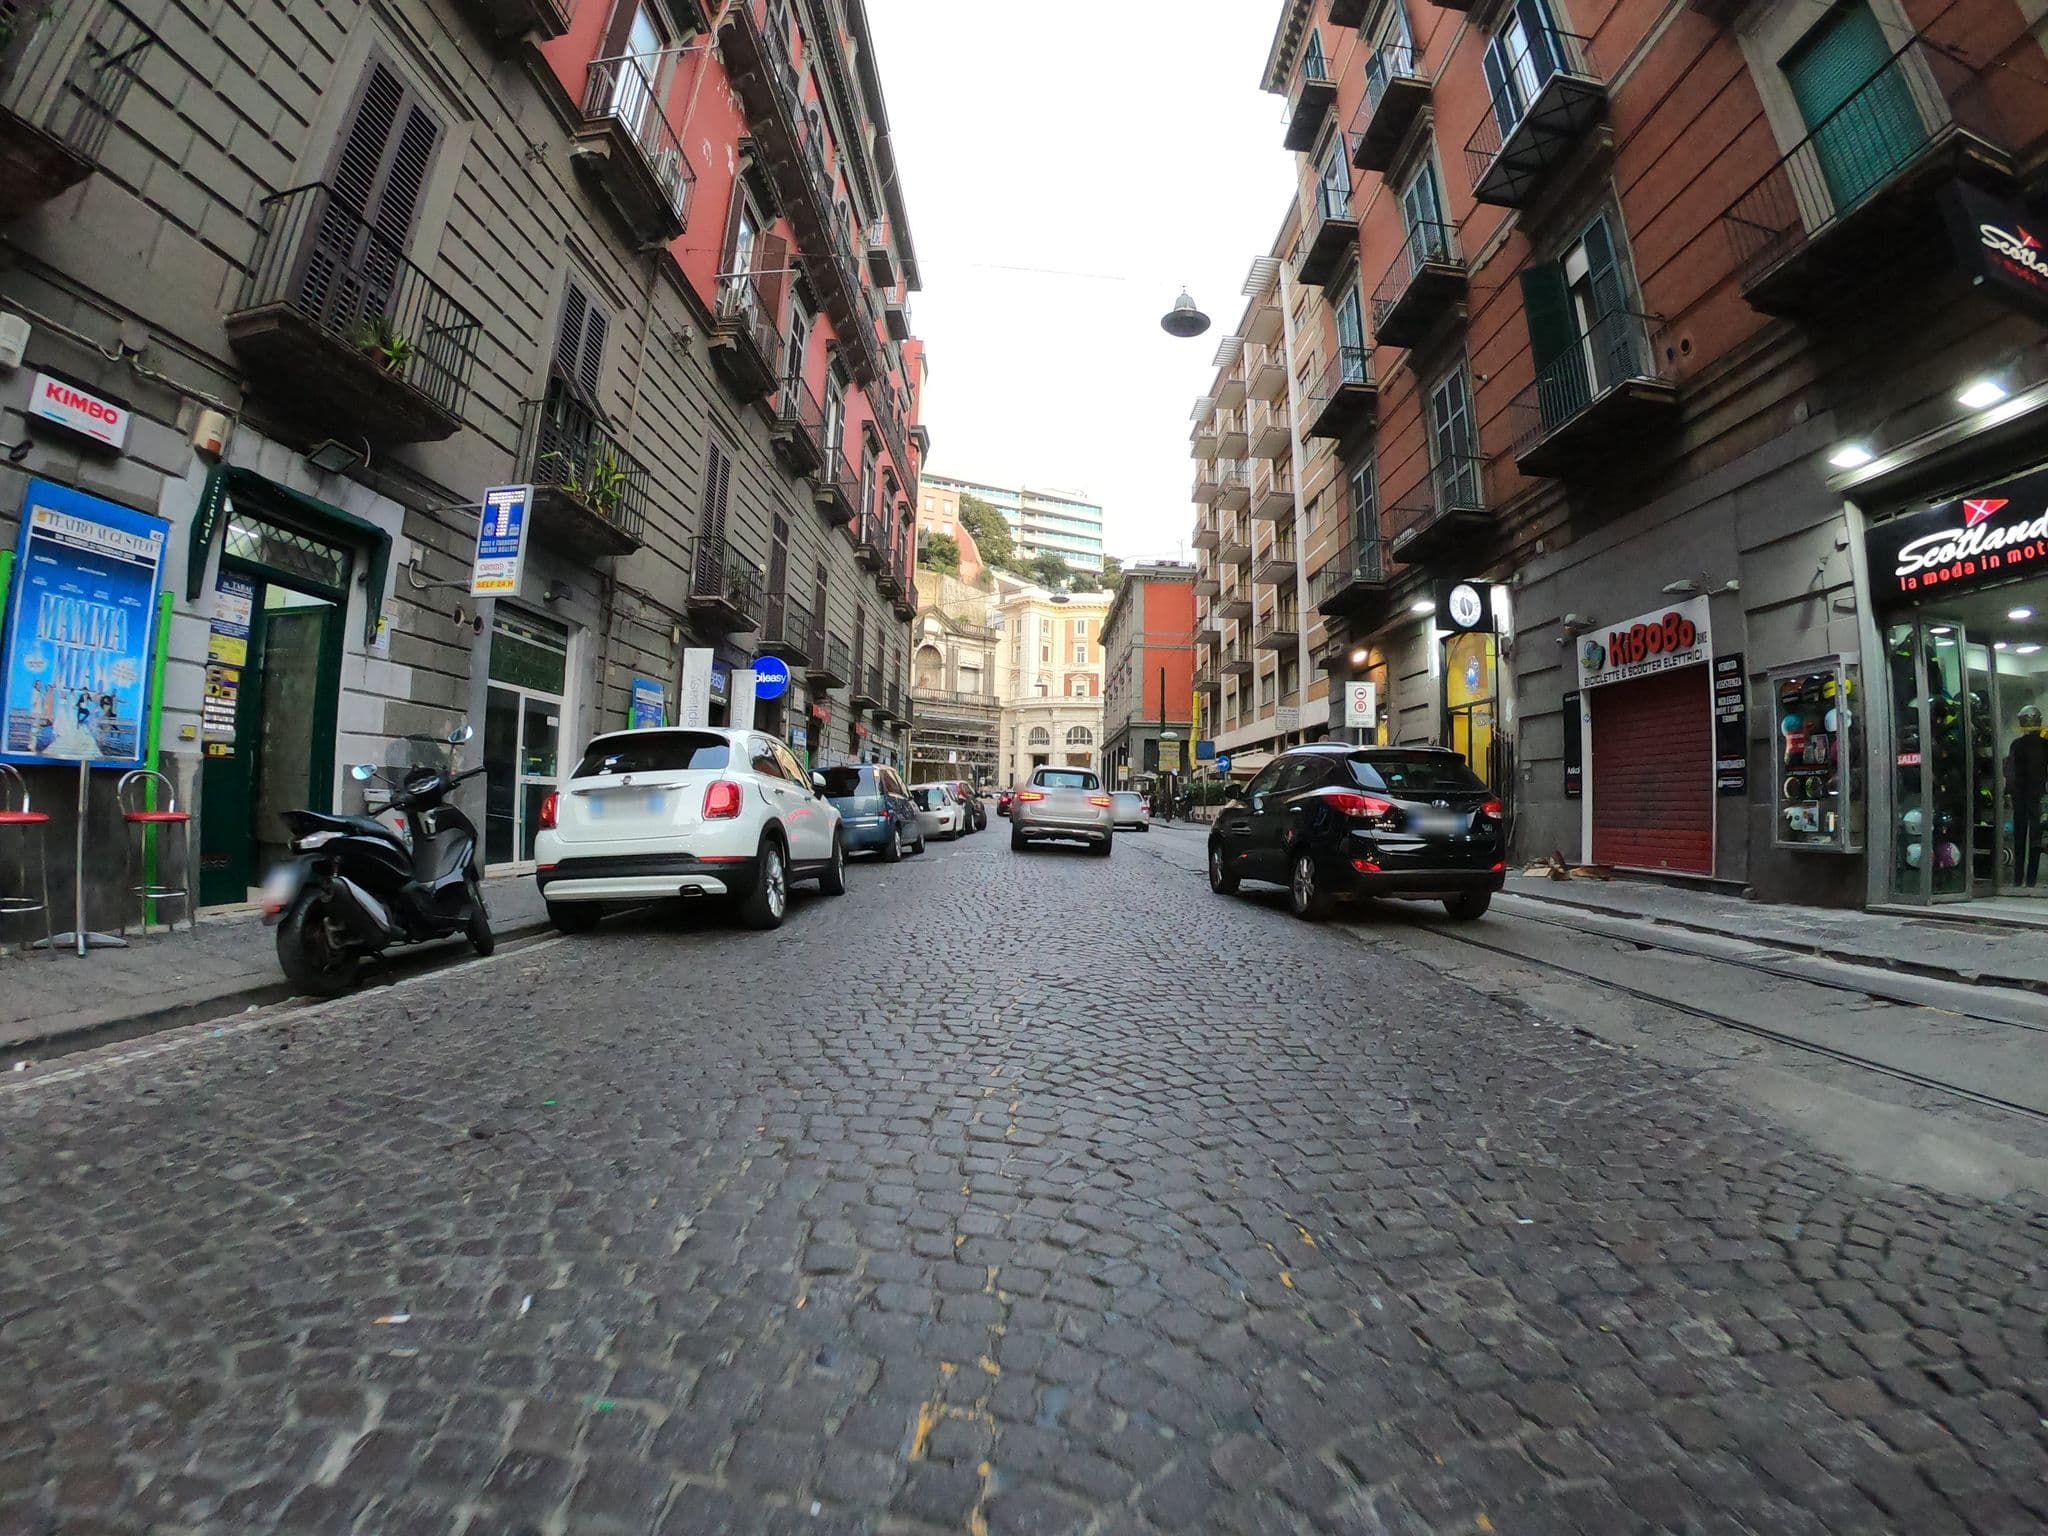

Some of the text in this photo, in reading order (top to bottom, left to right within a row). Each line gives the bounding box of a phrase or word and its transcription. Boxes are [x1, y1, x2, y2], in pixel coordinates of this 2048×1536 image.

[1980, 224, 2048, 278] Scotla
[45, 382, 118, 425] KIMBO
[47, 511, 93, 535] TEATRO
[97, 528, 154, 554] AUGUSTEO
[488, 490, 525, 537] T
[1895, 506, 2048, 576] Scotland
[1900, 540, 2048, 591] la moda in mot
[39, 592, 128, 654] MAMMA
[755, 671, 787, 683] pileasy
[1584, 671, 1621, 687] BICICLETTE
[1628, 660, 1662, 678] SCOOTER
[1663, 648, 1703, 668] ELETTRICI
